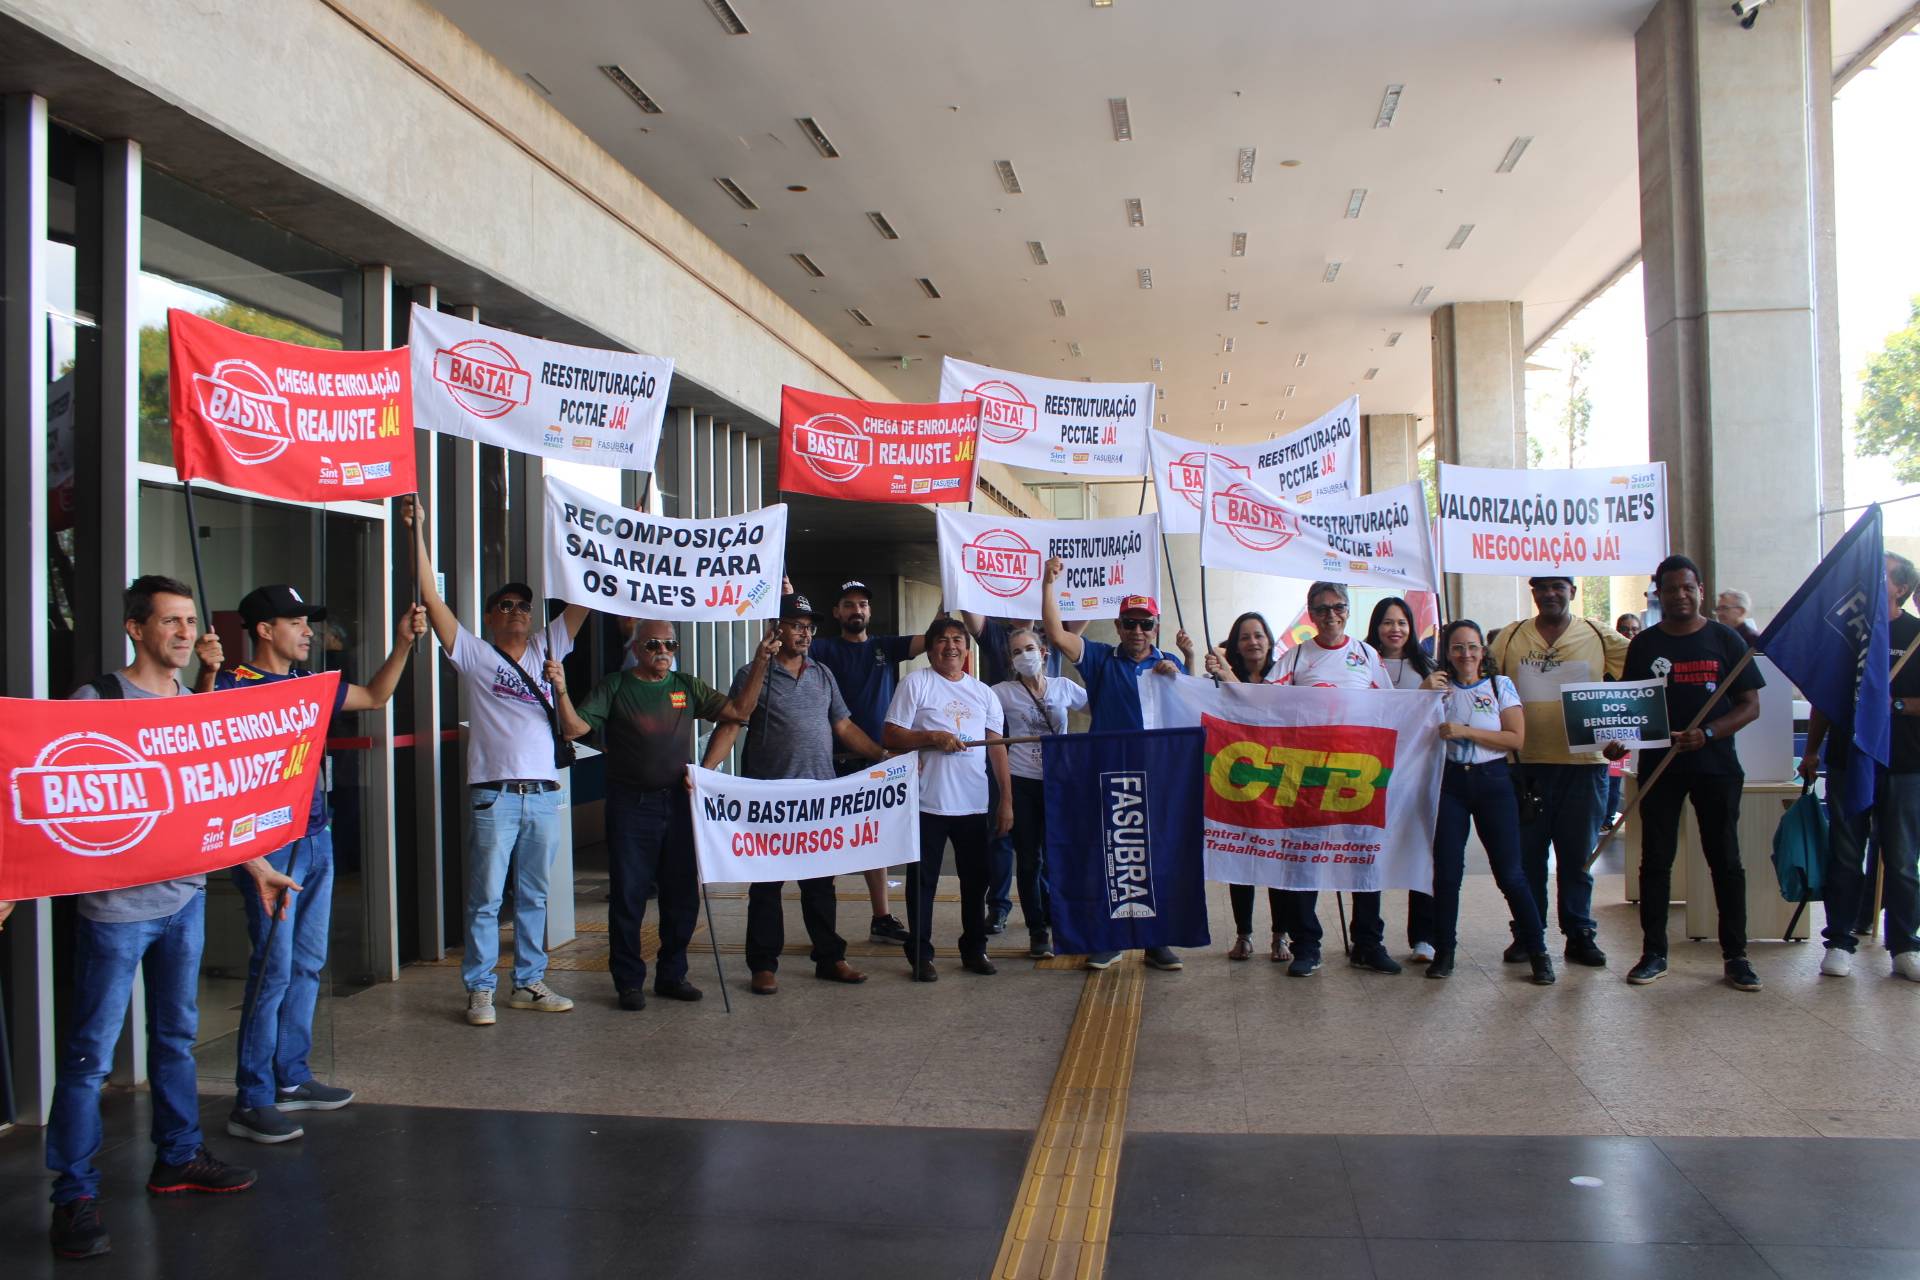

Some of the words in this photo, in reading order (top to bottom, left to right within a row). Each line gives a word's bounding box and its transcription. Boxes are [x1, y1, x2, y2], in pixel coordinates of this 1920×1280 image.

[276, 367, 317, 396] CHEGA
[319, 373, 334, 397] DE
[335, 367, 400, 400] ENROLAÇÃO
[449, 358, 514, 398] BASTA!
[541, 361, 656, 403] REESTRUTURAÇÃO
[296, 408, 376, 442] REAJUSTE
[378, 400, 400, 438] JÁ!
[558, 398, 608, 428] PCCTAE
[608, 400, 629, 431] JÁ!
[977, 398, 1024, 427] ASTA!
[1044, 394, 1137, 423] REESTRUTURAÇÃO
[543, 433, 564, 444] Sint
[863, 416, 899, 435] CHEGA
[902, 420, 915, 436] DE
[917, 414, 978, 438] ENROLAÇÃO
[1061, 424, 1099, 445] PCCTAE
[1101, 422, 1118, 445] JÁ!
[597, 440, 629, 452] FASUBRA
[807, 432, 859, 461] BASTA!
[879, 443, 951, 465] REAJUSTE
[954, 436, 975, 462] JÁ!
[1050, 452, 1066, 460] Sint
[1258, 416, 1351, 470] REESTRUTURAÇÃO
[320, 467, 338, 478] Sint
[1093, 454, 1119, 462] FASUBRA
[1279, 460, 1319, 492] PCCTAE
[1320, 449, 1336, 478] JÁ!
[890, 482, 907, 490] Sint
[1631, 472, 1655, 483] Sint
[1440, 493, 1558, 532] VALORIZAÇÃO
[1563, 497, 1600, 526] DOS
[1604, 492, 1655, 523] TAE'S
[564, 502, 764, 554] RECOMPOSIÇÃO
[566, 533, 687, 578] SALARIAL
[695, 553, 761, 578] PARA
[1049, 530, 1142, 561] REESTRUTURAÇÃO
[1375, 536, 1394, 558] JÁ!
[1472, 532, 1588, 569] NEGOCIAÇÃO
[1592, 529, 1621, 562] JÁ!
[976, 550, 1027, 576] BASTA!
[1067, 566, 1106, 589] PCCTAE
[1107, 560, 1125, 586] JÁ!
[1323, 558, 1342, 568] Sint
[583, 569, 618, 597] OS
[626, 578, 697, 608] TAE'S
[704, 580, 743, 608] JÁ!
[747, 579, 767, 601] Sint
[1571, 687, 1655, 702] EQUIPARAÇÃO
[1602, 703, 1627, 713] DOS
[137, 727, 197, 757] CHEGA
[200, 720, 224, 748] DE
[227, 699, 321, 744] ENROLAÇÃO
[1583, 714, 1649, 728] BENEFÍCIOS
[1596, 728, 1634, 741] FASUBRA
[178, 749, 287, 804] REAJUSTE
[282, 734, 312, 781] JÁ!
[886, 765, 907, 777] Sint
[1209, 741, 1382, 813] CTB
[42, 772, 149, 815] BASTA!
[704, 793, 742, 822] NÃO
[747, 798, 825, 824] BASTAM
[829, 782, 907, 819] PRÉDIOS
[256, 809, 288, 827] FASUBRA
[203, 830, 225, 846] Sint
[731, 826, 844, 857] CONCURSOS
[849, 816, 880, 848] JÁ!
[1110, 776, 1149, 902] FASUBRA
[1203, 827, 1247, 842] entral
[1250, 834, 1275, 847] dos
[1280, 838, 1381, 853] Trabalhadores
[1206, 839, 1307, 864] Trabalhadoras
[1311, 852, 1329, 864] do
[1333, 853, 1376, 865] Brasil
